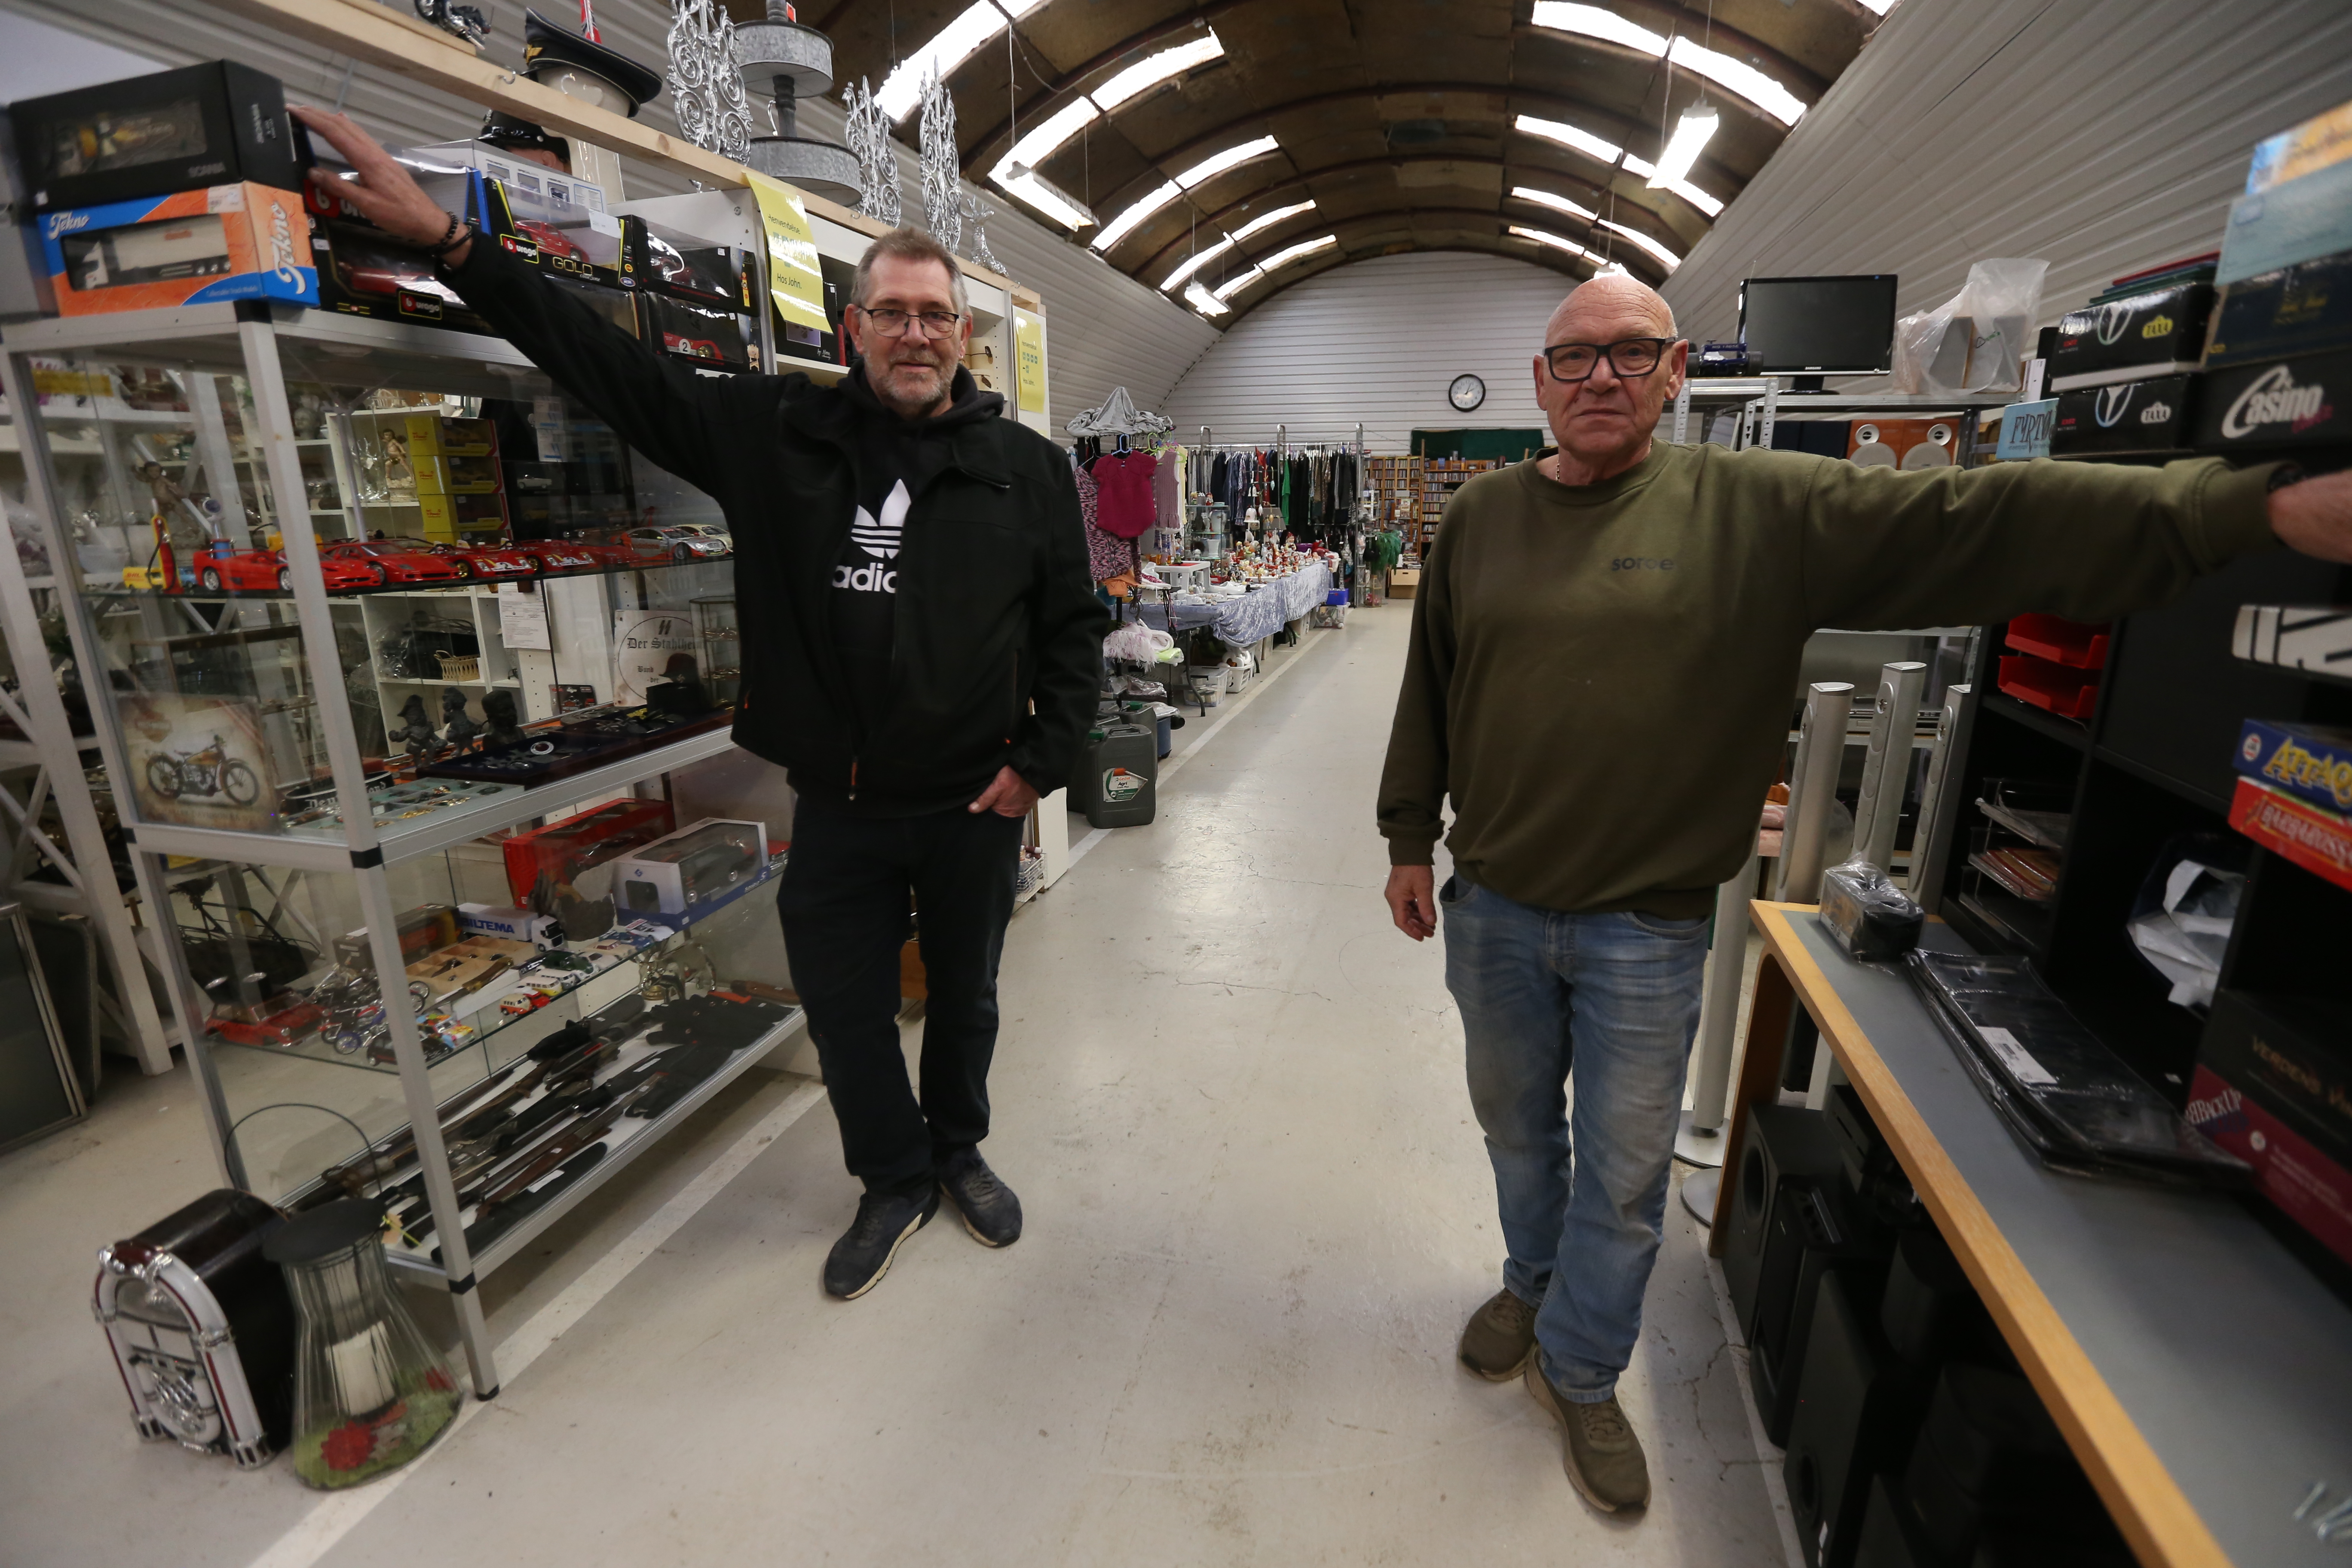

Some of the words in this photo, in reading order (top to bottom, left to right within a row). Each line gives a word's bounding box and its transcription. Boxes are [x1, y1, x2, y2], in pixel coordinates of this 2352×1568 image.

[48, 210, 90, 241] Tekno
[768, 214, 801, 234] Henvendelse
[270, 200, 306, 294] Tekno
[507, 240, 537, 257] burago
[553, 257, 592, 276] GOLD
[777, 273, 787, 284] Hos
[788, 276, 802, 289] John.
[2147, 324, 2168, 335] TAXA
[683, 342, 688, 352] 2
[2222, 364, 2324, 439] Casino
[2146, 410, 2167, 420] TAXA
[627, 638, 648, 649] Der
[461, 917, 514, 934] BILTEMA
